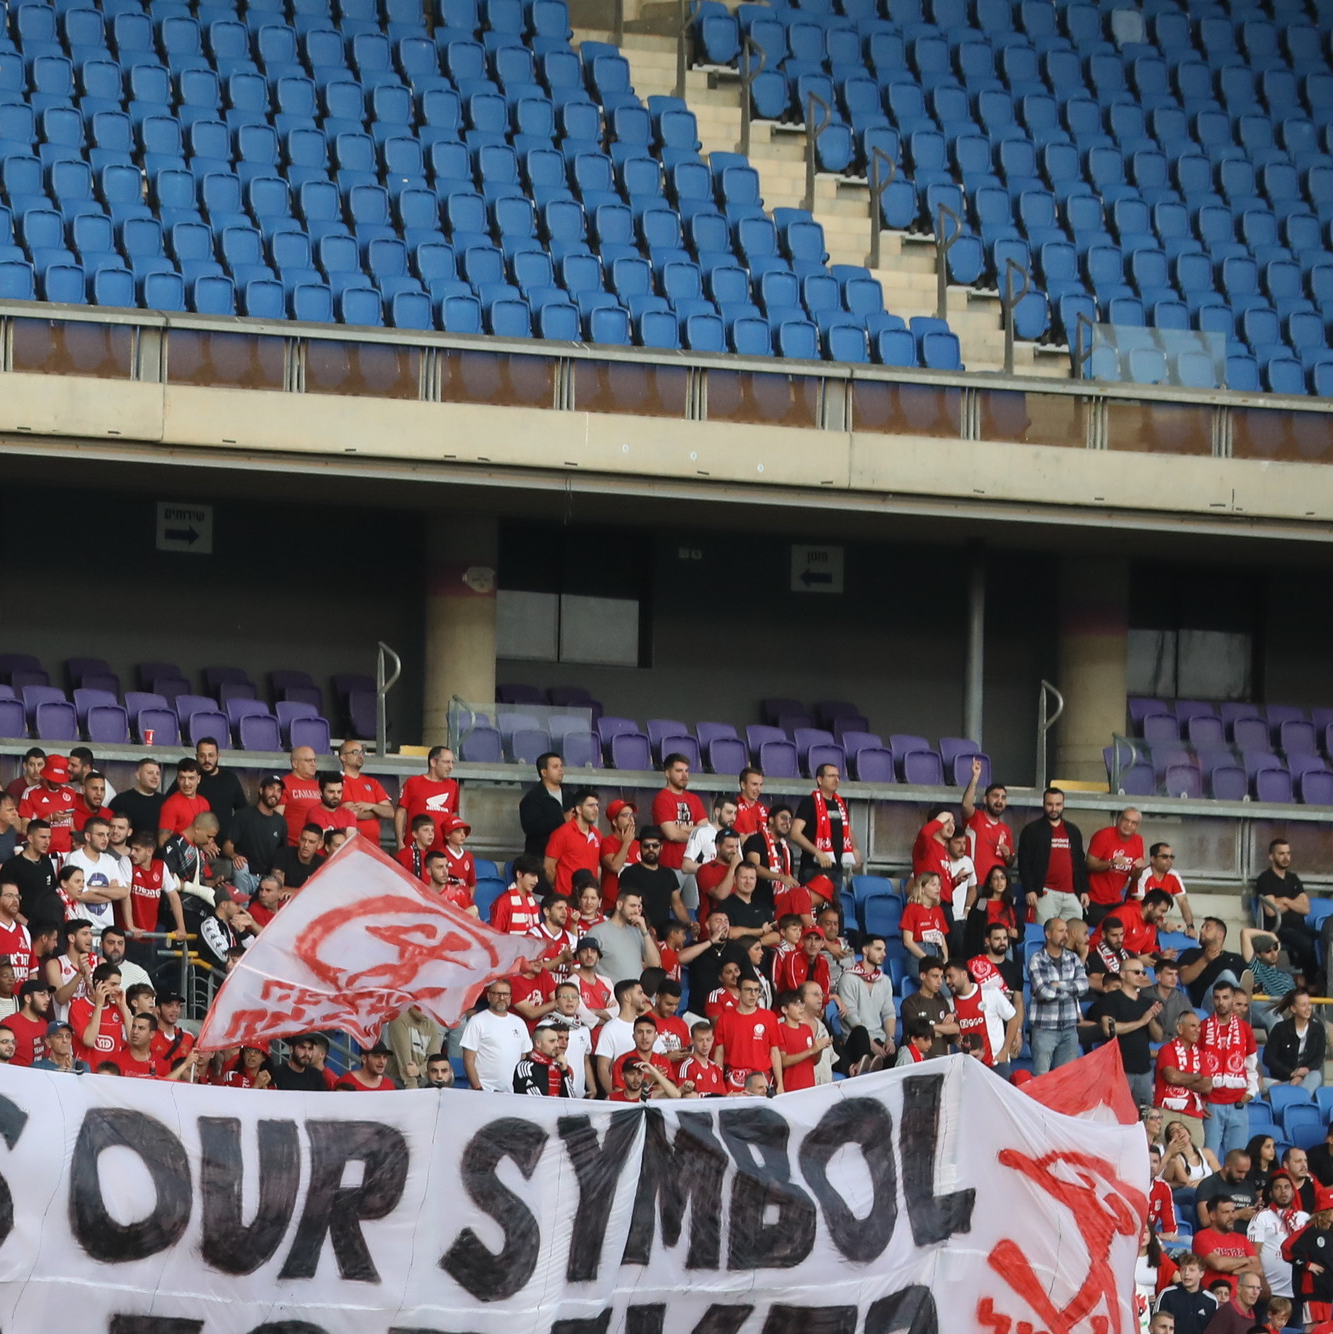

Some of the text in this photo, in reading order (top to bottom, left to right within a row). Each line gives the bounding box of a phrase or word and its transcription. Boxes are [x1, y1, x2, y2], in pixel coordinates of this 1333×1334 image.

[164, 508, 205, 521] שירותים
[69, 1106, 410, 1284] OUR
[438, 1073, 976, 1303] SYMBOL
